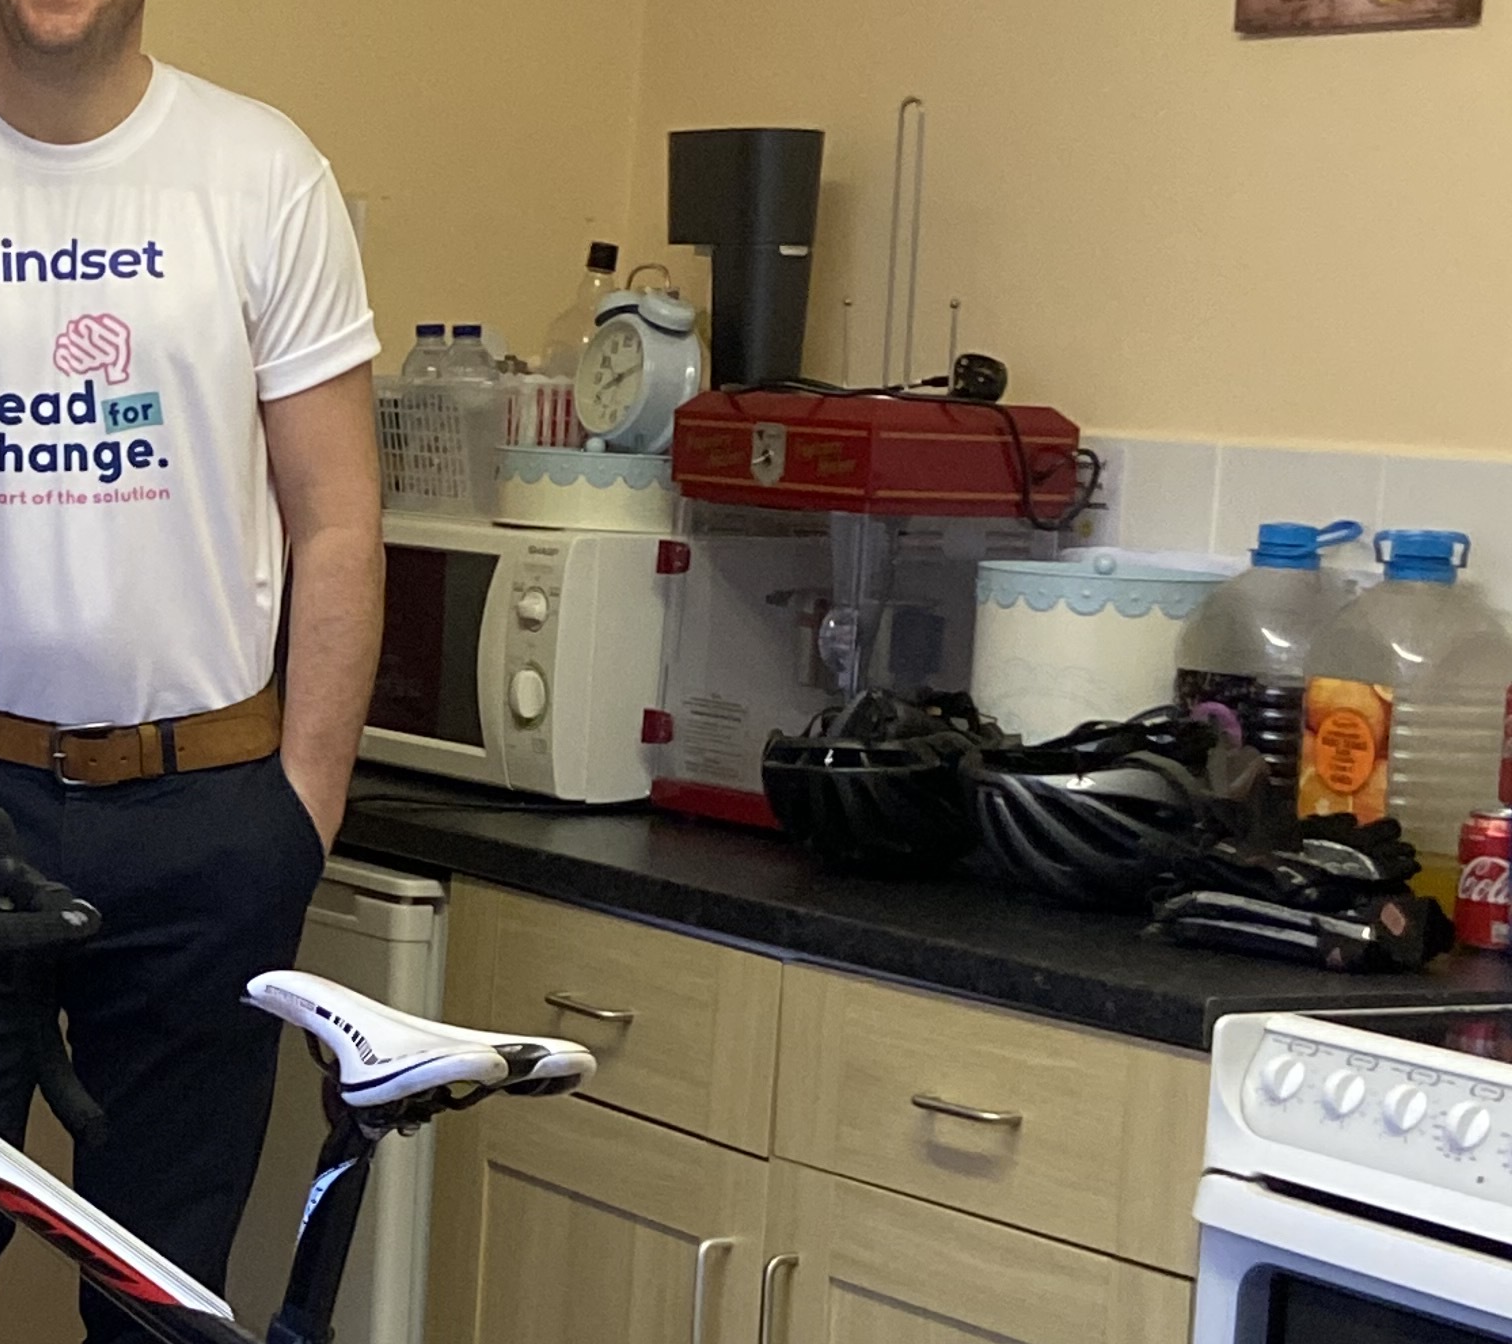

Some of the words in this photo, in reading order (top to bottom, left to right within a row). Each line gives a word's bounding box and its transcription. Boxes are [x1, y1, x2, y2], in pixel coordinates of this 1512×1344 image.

[108, 402, 153, 426] for
[32, 490, 54, 505] of
[57, 489, 88, 505] the
[92, 485, 171, 504] solution
